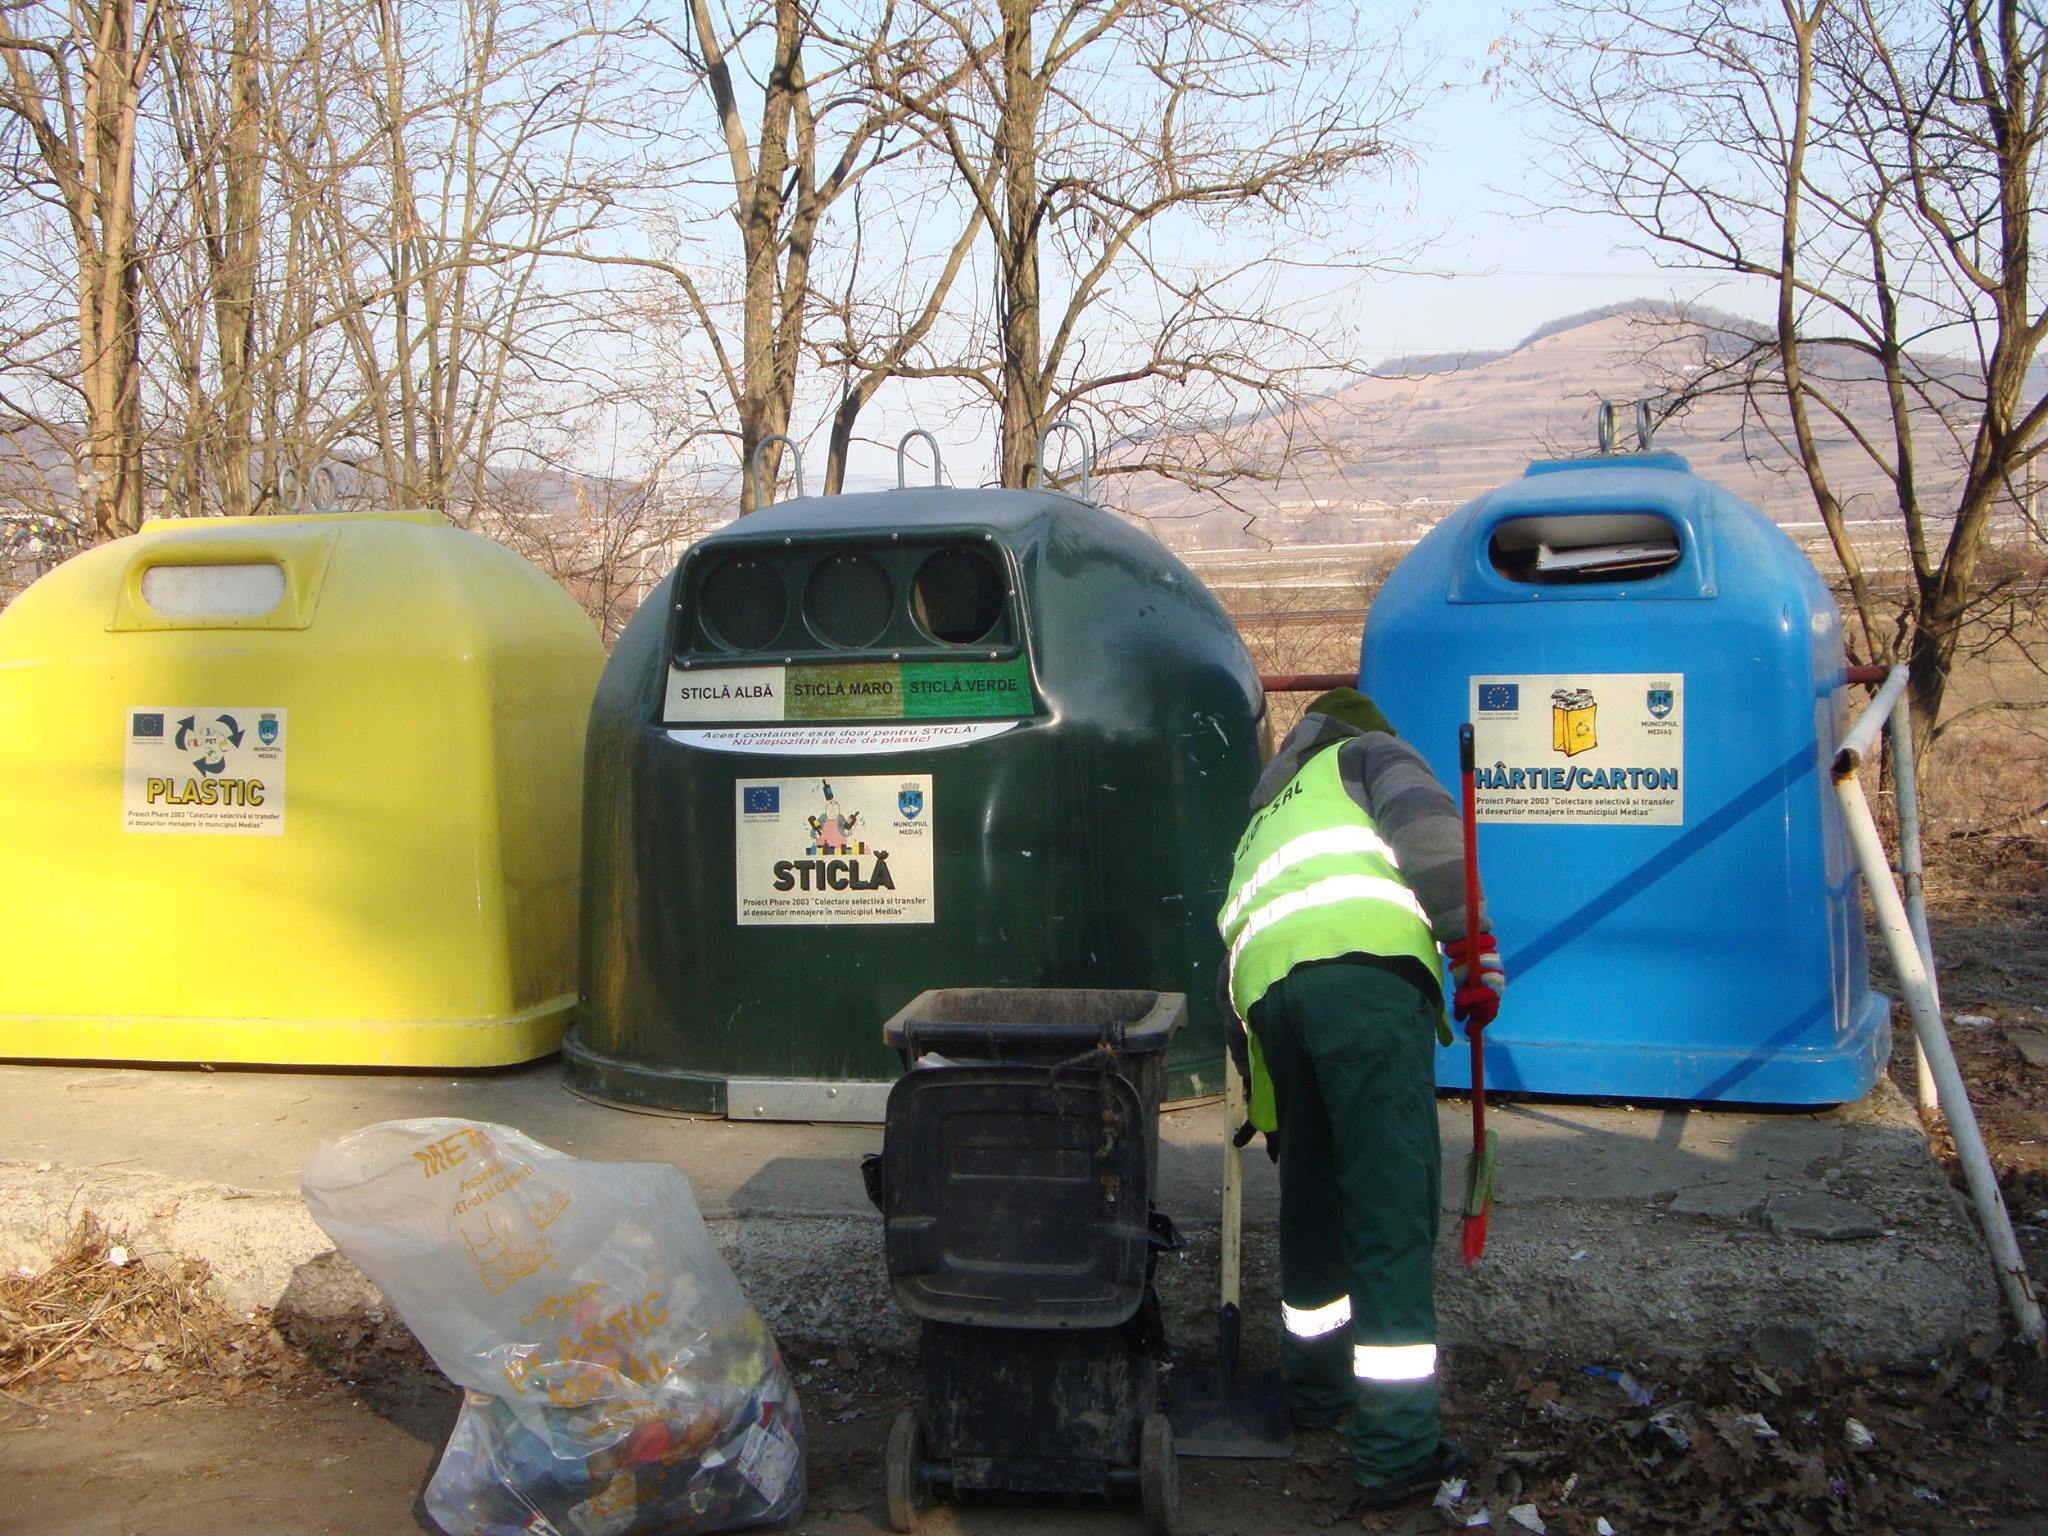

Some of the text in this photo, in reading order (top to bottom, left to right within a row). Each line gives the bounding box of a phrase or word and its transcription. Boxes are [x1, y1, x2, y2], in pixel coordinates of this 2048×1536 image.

[794, 681, 893, 697] STICLĂ MARO
[967, 678, 1017, 692] VERDE
[681, 683, 773, 699] STICLĂ ALBĂ
[1641, 720, 1679, 728] MUNICIPIUL
[701, 731, 742, 739] Acest
[743, 730, 805, 738] container
[808, 730, 836, 738] este
[839, 729, 872, 737] doar
[873, 728, 919, 737] pentru
[732, 738, 752, 746] NU
[821, 737, 857, 745] sticle
[861, 736, 877, 744] de
[880, 735, 931, 745] plastic!
[1475, 761, 1679, 791] HÂRTIE/CARTON
[146, 777, 265, 807] PLASTIC
[1476, 797, 1503, 805] Proiect
[1505, 797, 1529, 805] Phare
[1530, 797, 1549, 805] 2003
[1641, 798, 1675, 806] transfer
[128, 810, 150, 818] Proiect
[254, 812, 280, 820] transfer
[1475, 807, 1483, 815] al
[1527, 808, 1565, 817] menajere
[1576, 808, 1618, 817] municipiul
[893, 820, 928, 828] MUNICIPIUL
[772, 850, 896, 892] STICLĂ
[743, 898, 768, 906] Proiect
[769, 898, 790, 906] Phare
[792, 898, 810, 906] 2003
[743, 908, 750, 916] al
[789, 909, 824, 917] menajere
[834, 908, 874, 917] municipiul
[502, 1290, 670, 1395] PLASTIC
